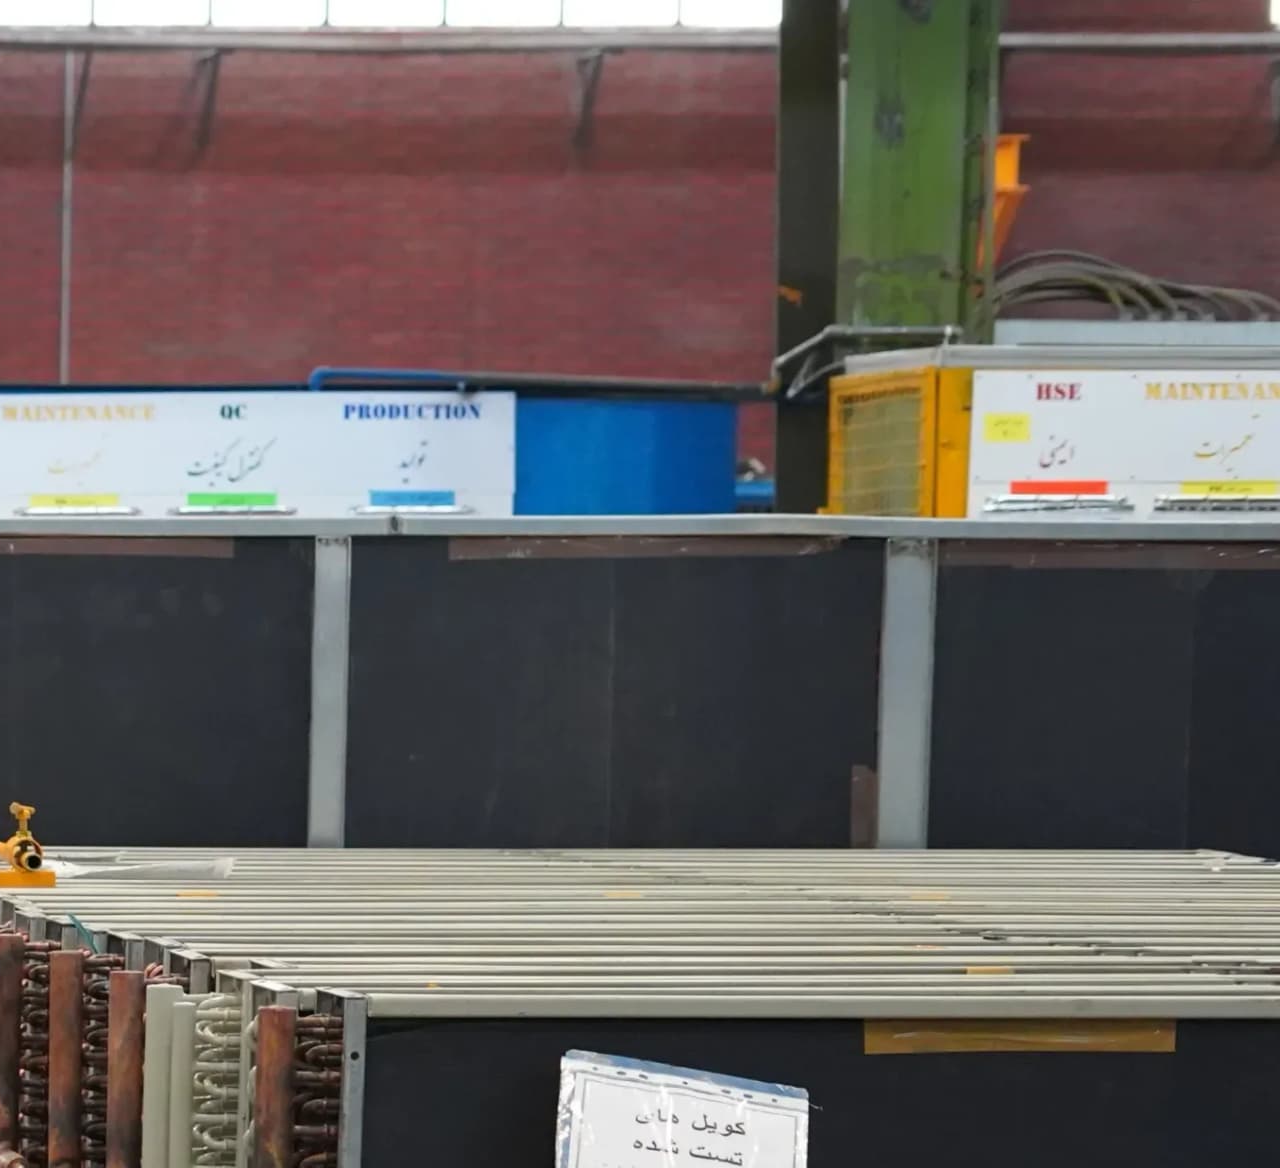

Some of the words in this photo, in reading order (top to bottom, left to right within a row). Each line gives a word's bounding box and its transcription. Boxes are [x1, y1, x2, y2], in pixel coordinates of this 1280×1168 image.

[1037, 383, 1081, 401] HSE
[1, 405, 156, 422] MAINTENANCE
[219, 404, 248, 420] QC
[342, 403, 481, 420] PRODUCTION
[691, 1113, 746, 1137] کویل
[633, 1138, 679, 1155] شده
[689, 1146, 743, 1167] تست
